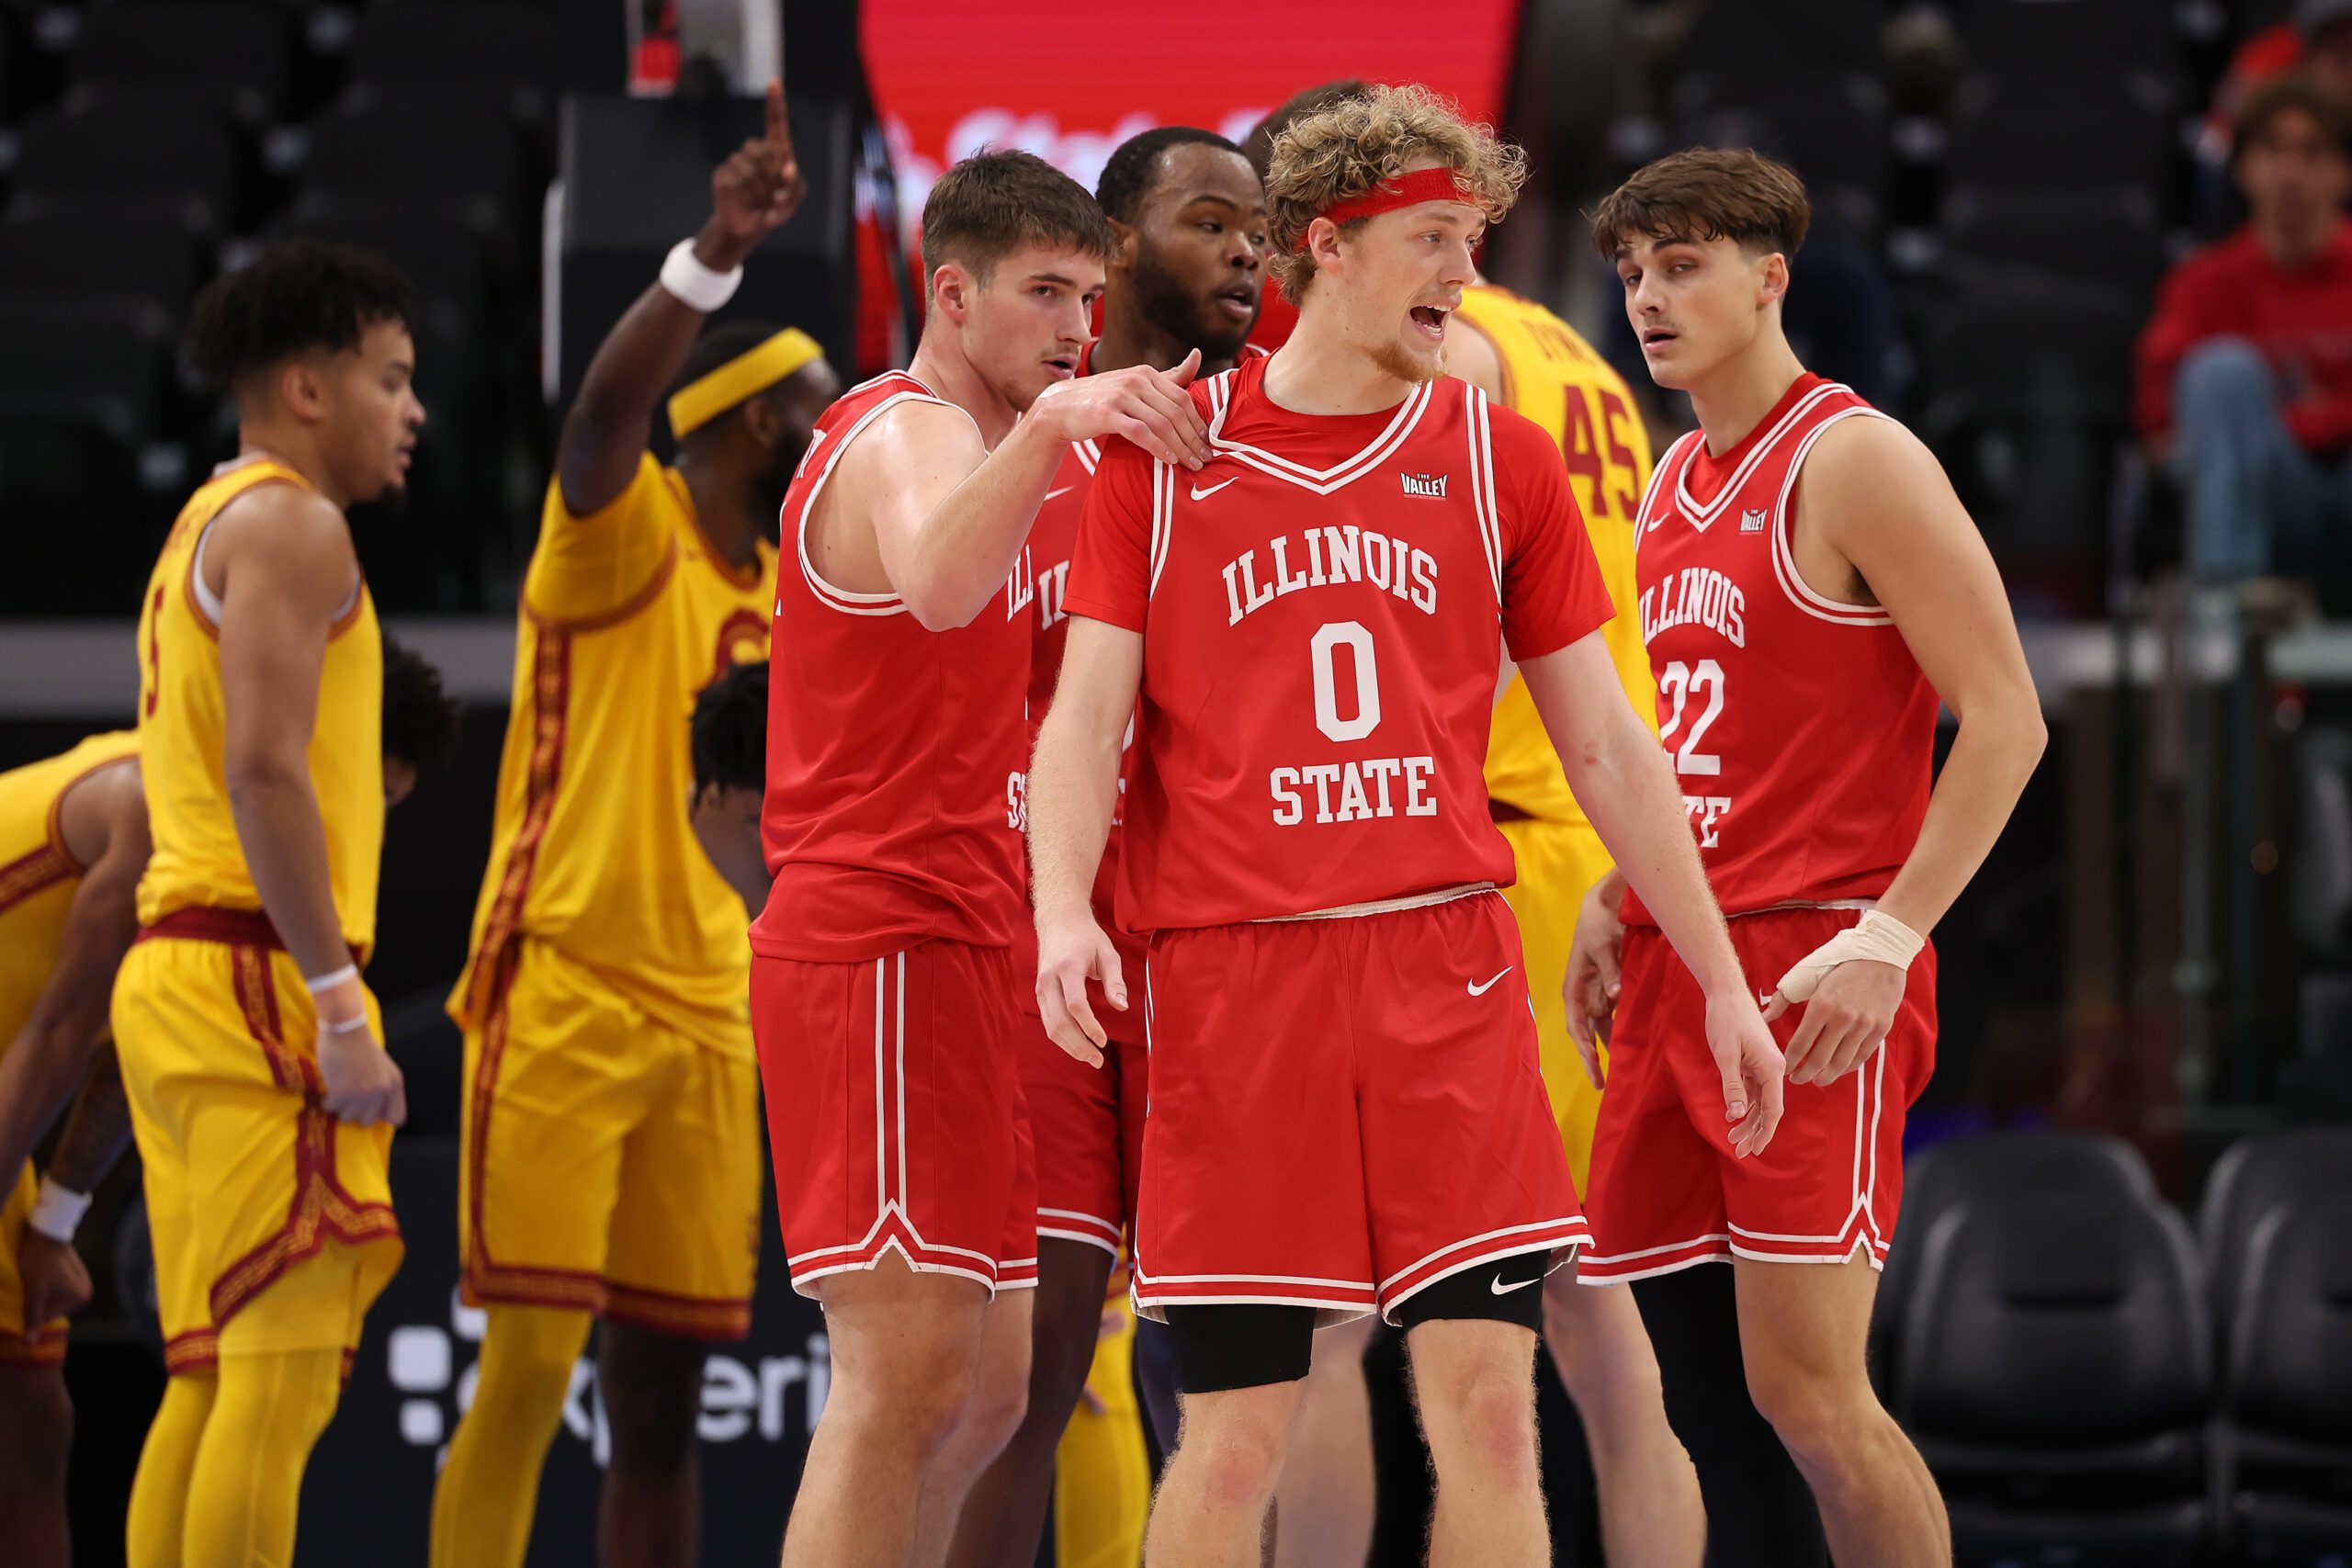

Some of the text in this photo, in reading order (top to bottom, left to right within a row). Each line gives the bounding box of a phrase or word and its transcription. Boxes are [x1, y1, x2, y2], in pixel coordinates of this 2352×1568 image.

[1399, 471, 1448, 497] VALLEY
[1564, 385, 1638, 521] 45
[1222, 525, 1438, 627] ILLINOIS
[1310, 621, 1381, 742] 0
[1659, 659, 1724, 775] 22
[1270, 756, 1438, 826] STATE
